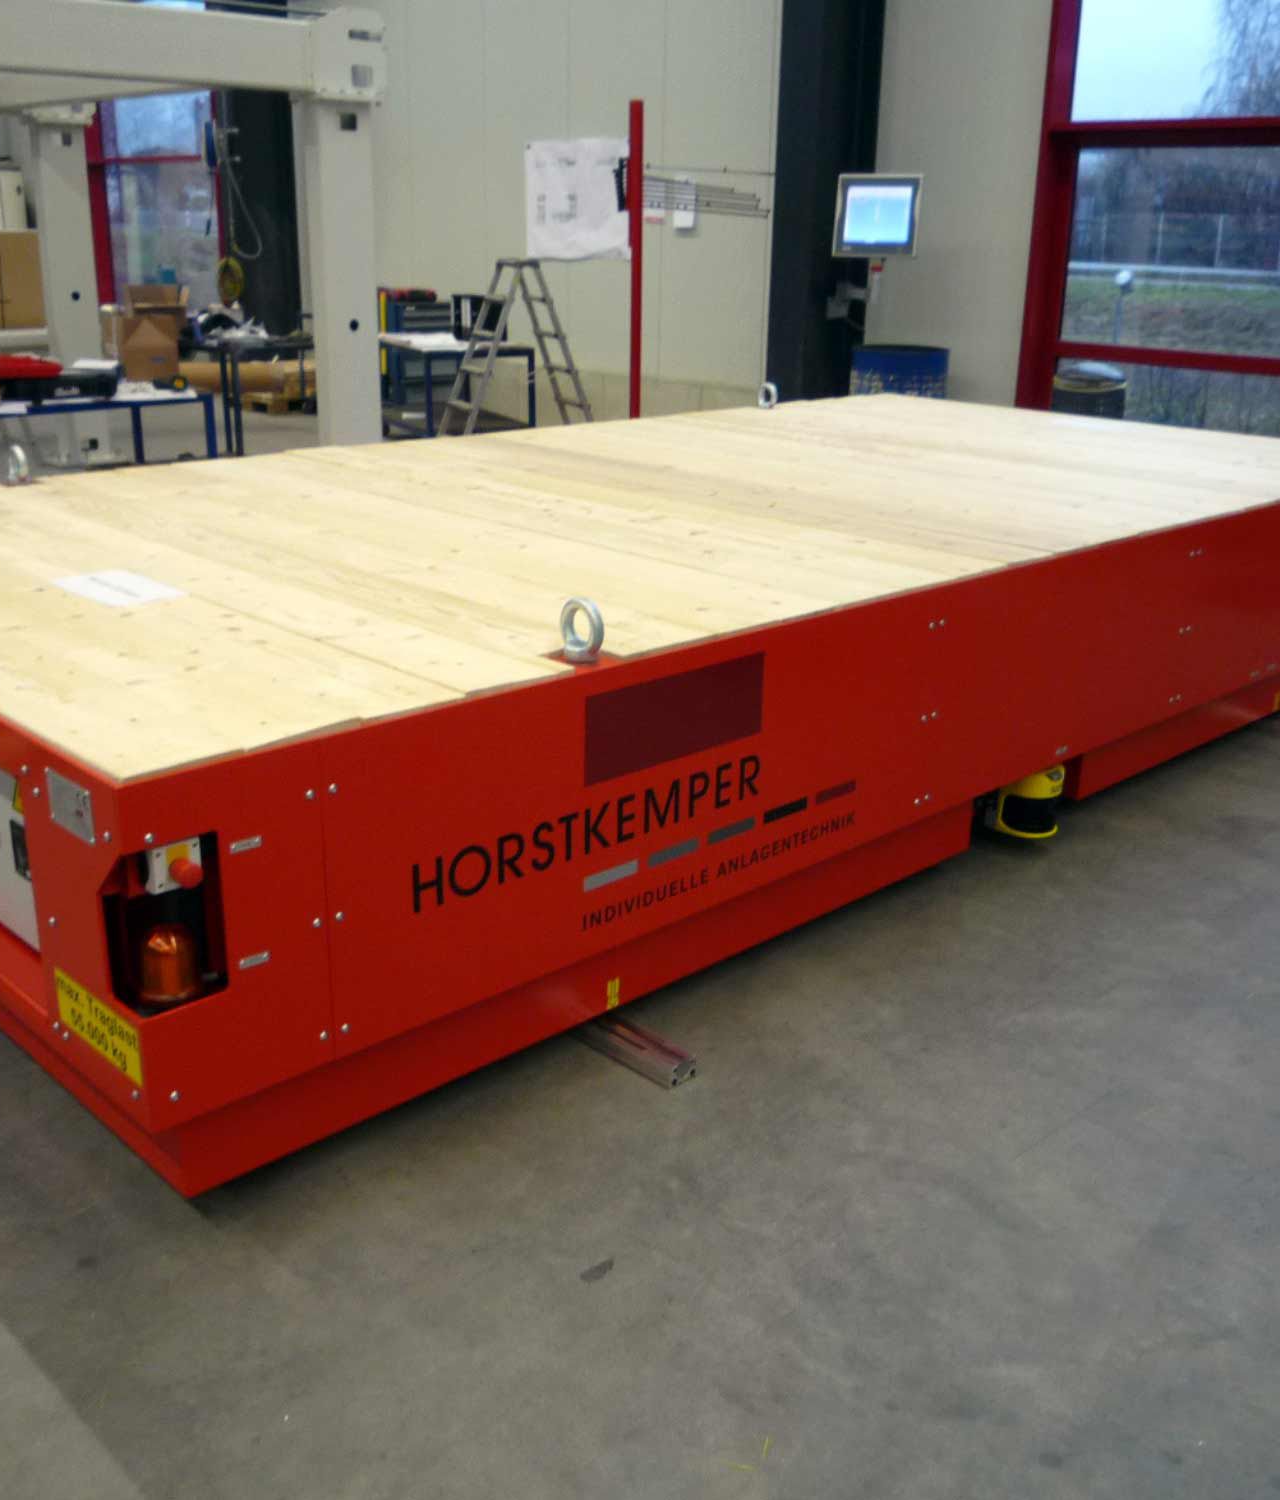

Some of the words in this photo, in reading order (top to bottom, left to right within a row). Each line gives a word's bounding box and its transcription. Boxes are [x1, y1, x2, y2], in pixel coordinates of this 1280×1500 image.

[412, 754, 761, 913] HORSTKEMPER
[581, 868, 710, 931] INDIVIDUELLE
[715, 812, 856, 878] ANLAGENTECHNIK
[111, 1040, 128, 1073] kg
